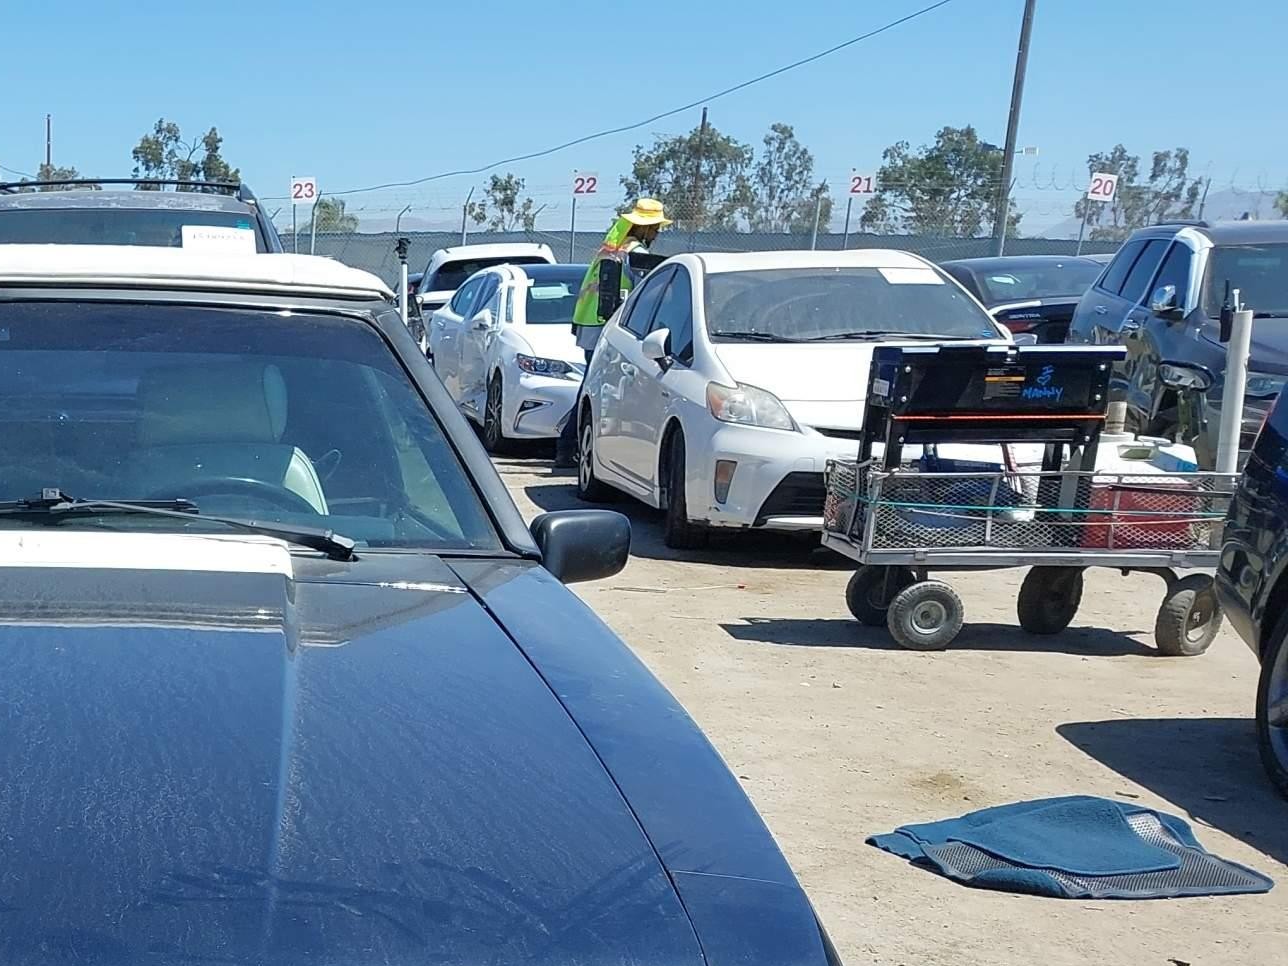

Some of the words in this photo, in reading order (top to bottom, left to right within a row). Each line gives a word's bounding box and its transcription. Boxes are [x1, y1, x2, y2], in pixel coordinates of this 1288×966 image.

[293, 183, 314, 198] 23
[574, 177, 597, 194] 22
[851, 176, 872, 193] 21
[1091, 178, 1114, 196] 20
[1022, 386, 1064, 403] MANNY
